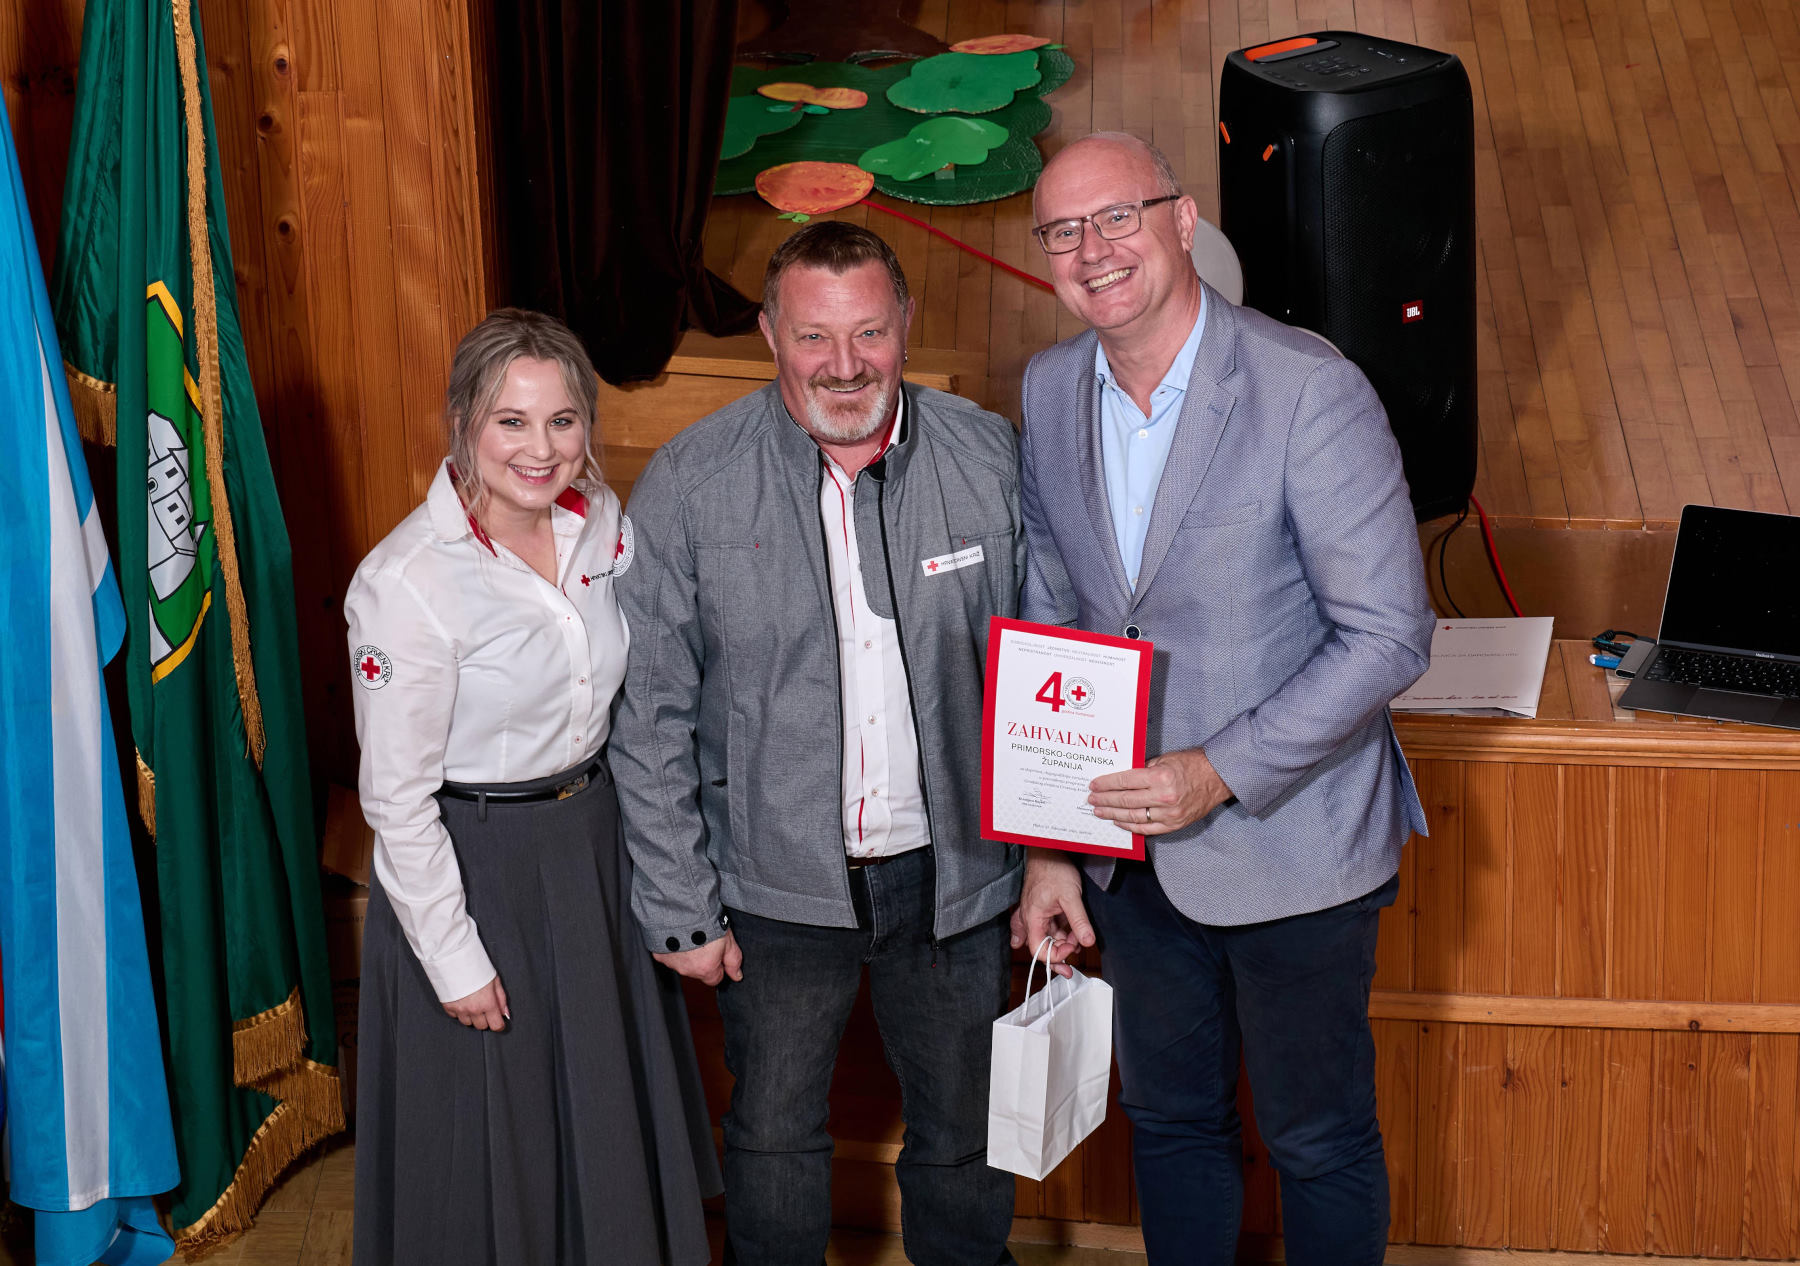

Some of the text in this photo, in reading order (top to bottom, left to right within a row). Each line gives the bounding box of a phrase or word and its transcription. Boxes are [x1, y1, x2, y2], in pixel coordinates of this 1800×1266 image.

[1406, 306, 1420, 318] JBL
[1007, 721, 1119, 752] ZAHVALNICA
[1011, 742, 1115, 767] PRIMORSKO-GORANSKA
[1041, 757, 1083, 771] ŽUPANIJA
